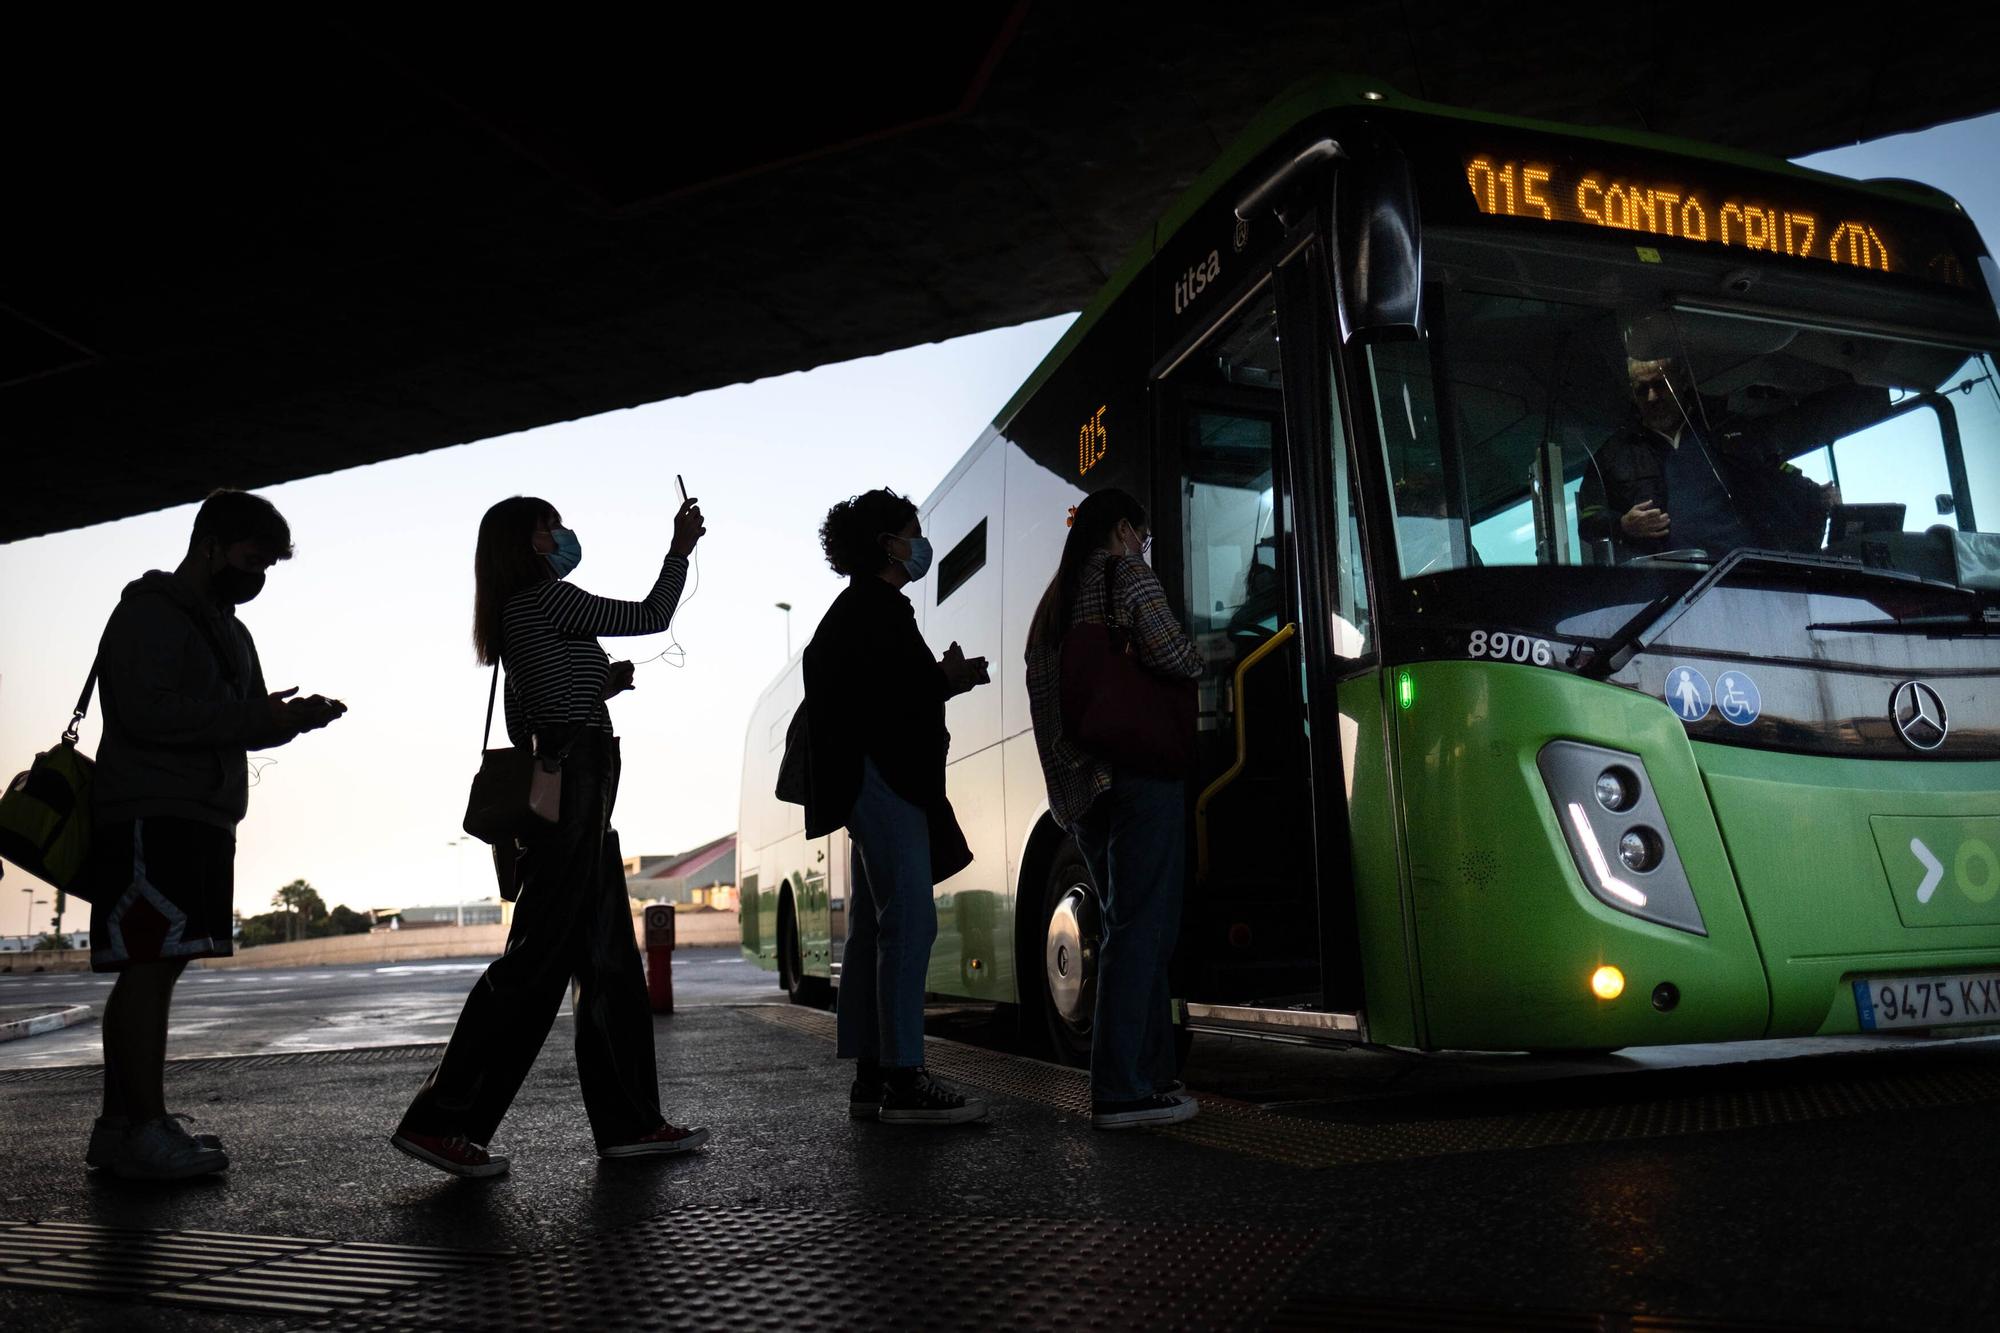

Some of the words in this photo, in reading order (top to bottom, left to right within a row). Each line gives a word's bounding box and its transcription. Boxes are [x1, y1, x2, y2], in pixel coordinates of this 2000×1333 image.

[1468, 160, 1551, 220] 015
[1175, 250, 1221, 314] titsa
[1079, 404, 1106, 476] 015
[1468, 630, 1550, 666] 8906
[1880, 983, 1953, 1020] 9475
[1959, 979, 2000, 1015] KX
